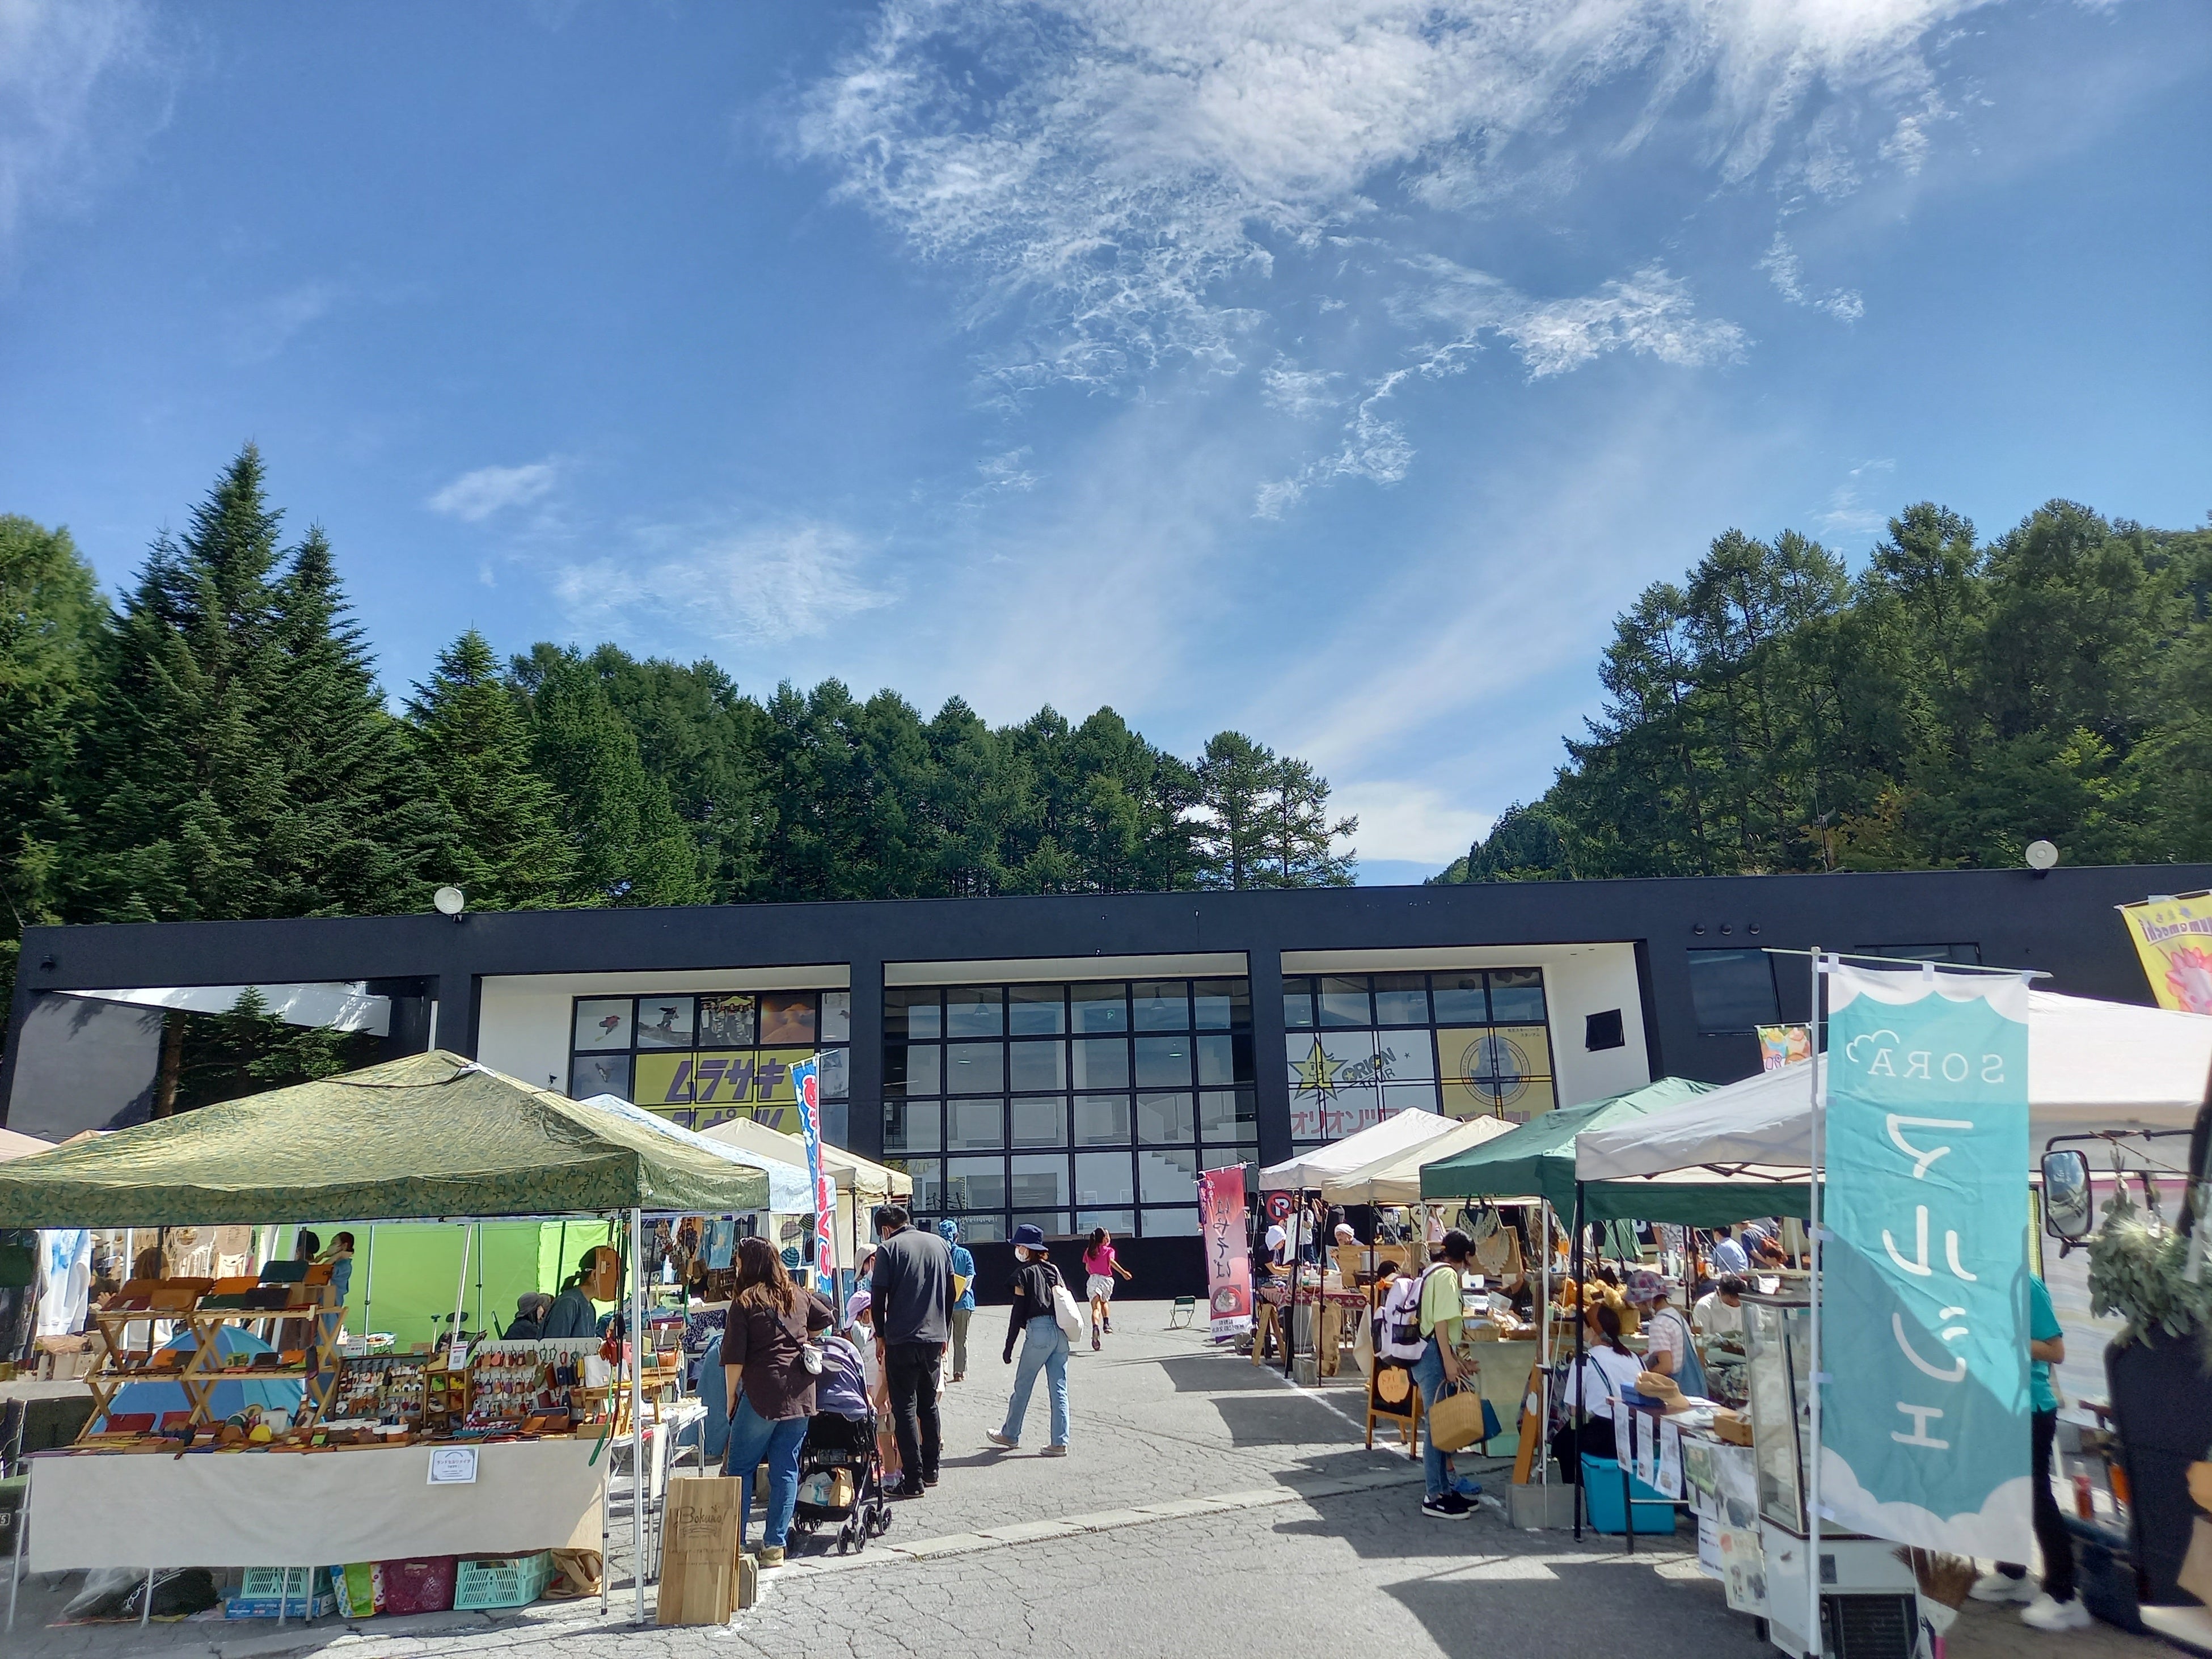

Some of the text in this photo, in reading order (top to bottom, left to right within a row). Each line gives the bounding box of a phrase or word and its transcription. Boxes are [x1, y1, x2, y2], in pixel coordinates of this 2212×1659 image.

[1342, 1047, 1397, 1082] ORION
[664, 1058, 787, 1103] ムラサキ
[1360, 1068, 1396, 1091] TOUR
[1275, 1198, 1289, 1216] P
